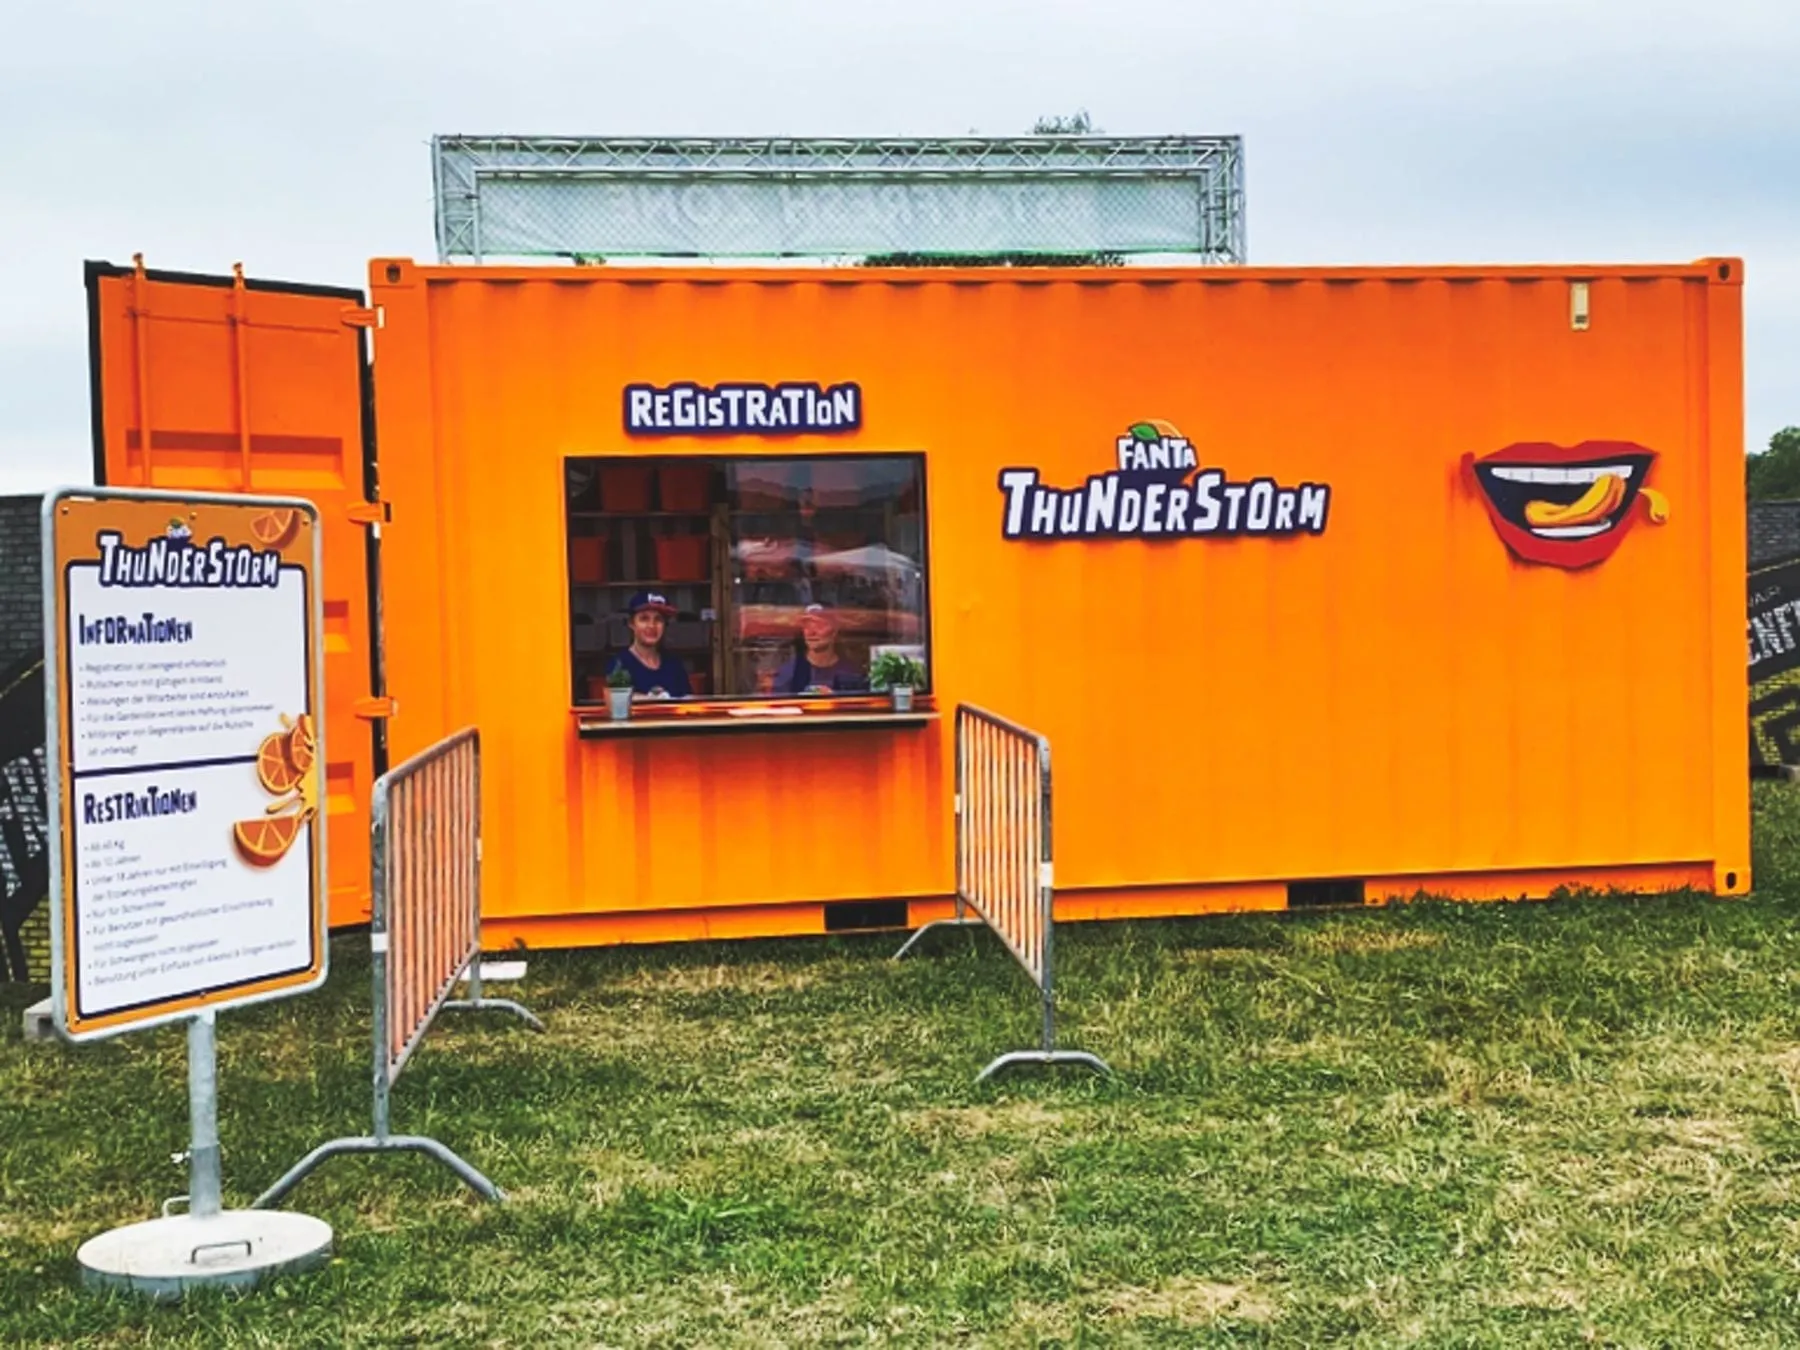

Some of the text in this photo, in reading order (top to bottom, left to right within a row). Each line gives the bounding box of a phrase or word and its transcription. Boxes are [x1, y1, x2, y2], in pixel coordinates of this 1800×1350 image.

[631, 388, 854, 427] REGISTRATION
[1118, 438, 1197, 470] FANTA
[1003, 472, 1327, 533] THUNDERSTORM
[100, 535, 278, 584] THUNDERSTORM
[79, 612, 193, 645] INFORMATIONEN
[84, 785, 197, 824] RESTRIKTIONEN
